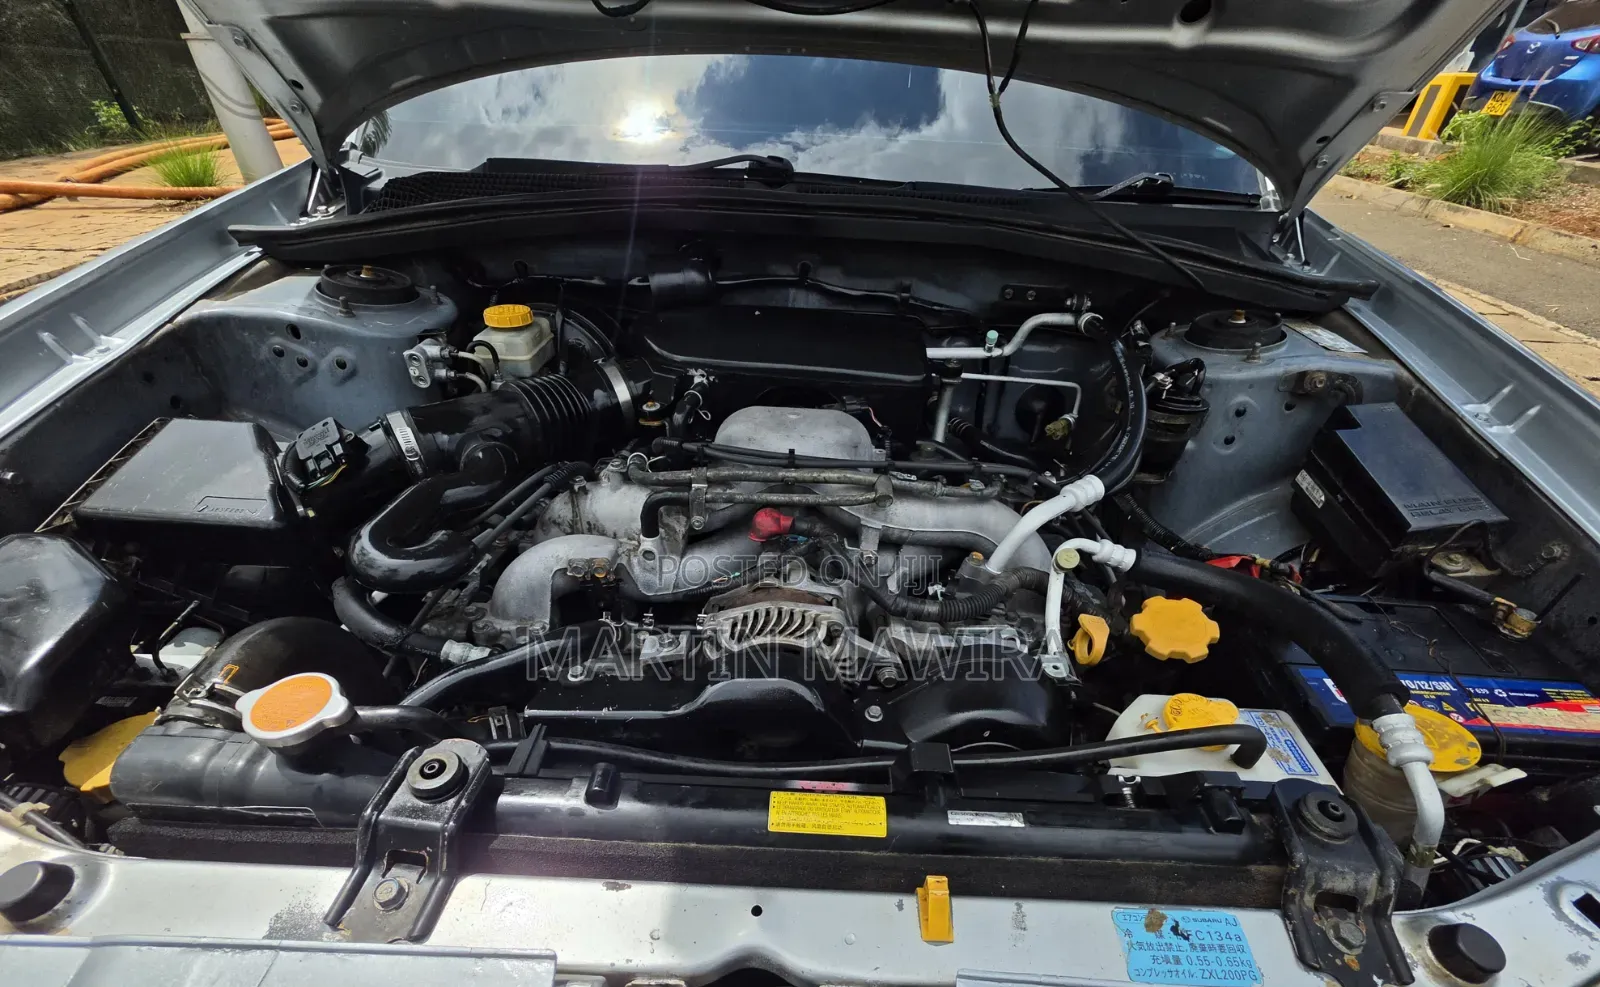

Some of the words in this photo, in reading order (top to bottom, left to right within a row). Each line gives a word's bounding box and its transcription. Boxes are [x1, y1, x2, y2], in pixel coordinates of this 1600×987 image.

[1225, 917, 1238, 927] AJ
[1185, 955, 1253, 969] 0.55-0.65kg
[1200, 968, 1258, 981] ZXL200PG
